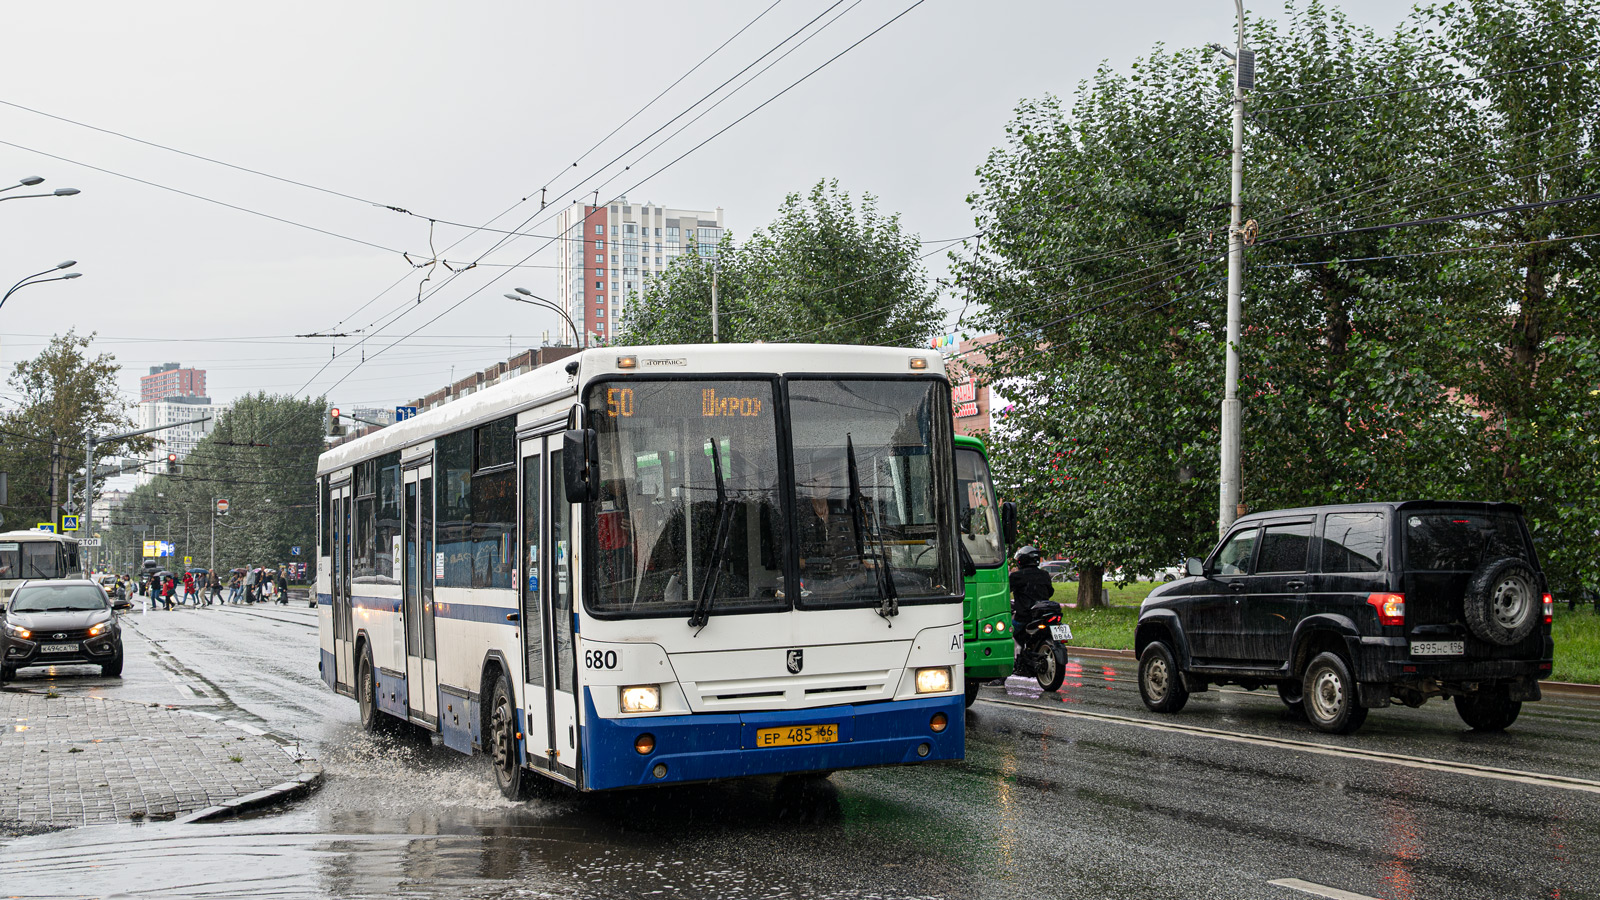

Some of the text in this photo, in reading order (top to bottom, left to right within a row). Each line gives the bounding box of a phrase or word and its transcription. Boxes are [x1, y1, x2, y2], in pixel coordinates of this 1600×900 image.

[607, 388, 634, 417] 50
[77, 538, 98, 546] СТОП
[1450, 642, 1463, 651] 196
[585, 650, 617, 669] 680
[764, 726, 833, 744] ЕР 485 66
